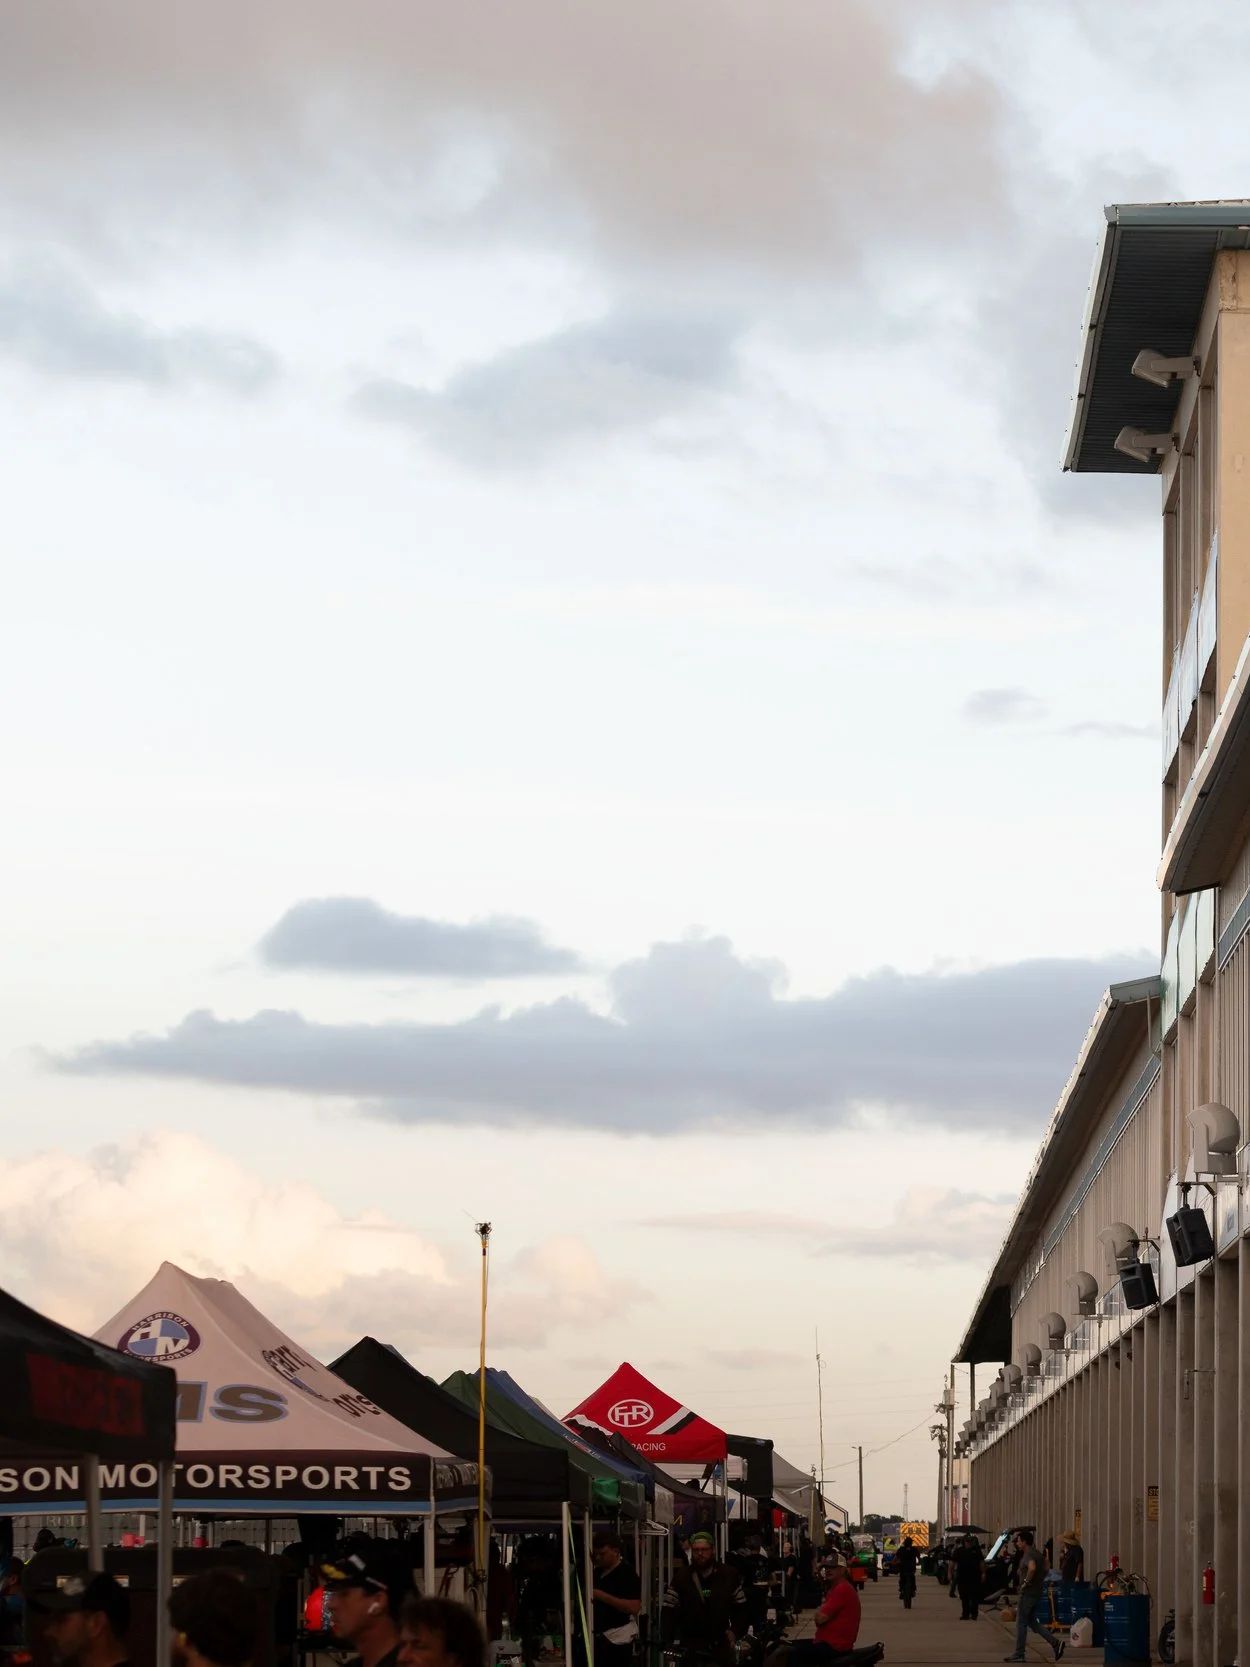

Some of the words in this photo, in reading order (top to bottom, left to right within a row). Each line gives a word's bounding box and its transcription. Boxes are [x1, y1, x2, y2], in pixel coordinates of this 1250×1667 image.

[131, 1312, 190, 1331] HARRISON
[123, 1348, 193, 1363] MRSPORTS
[0, 1465, 79, 1493] SON
